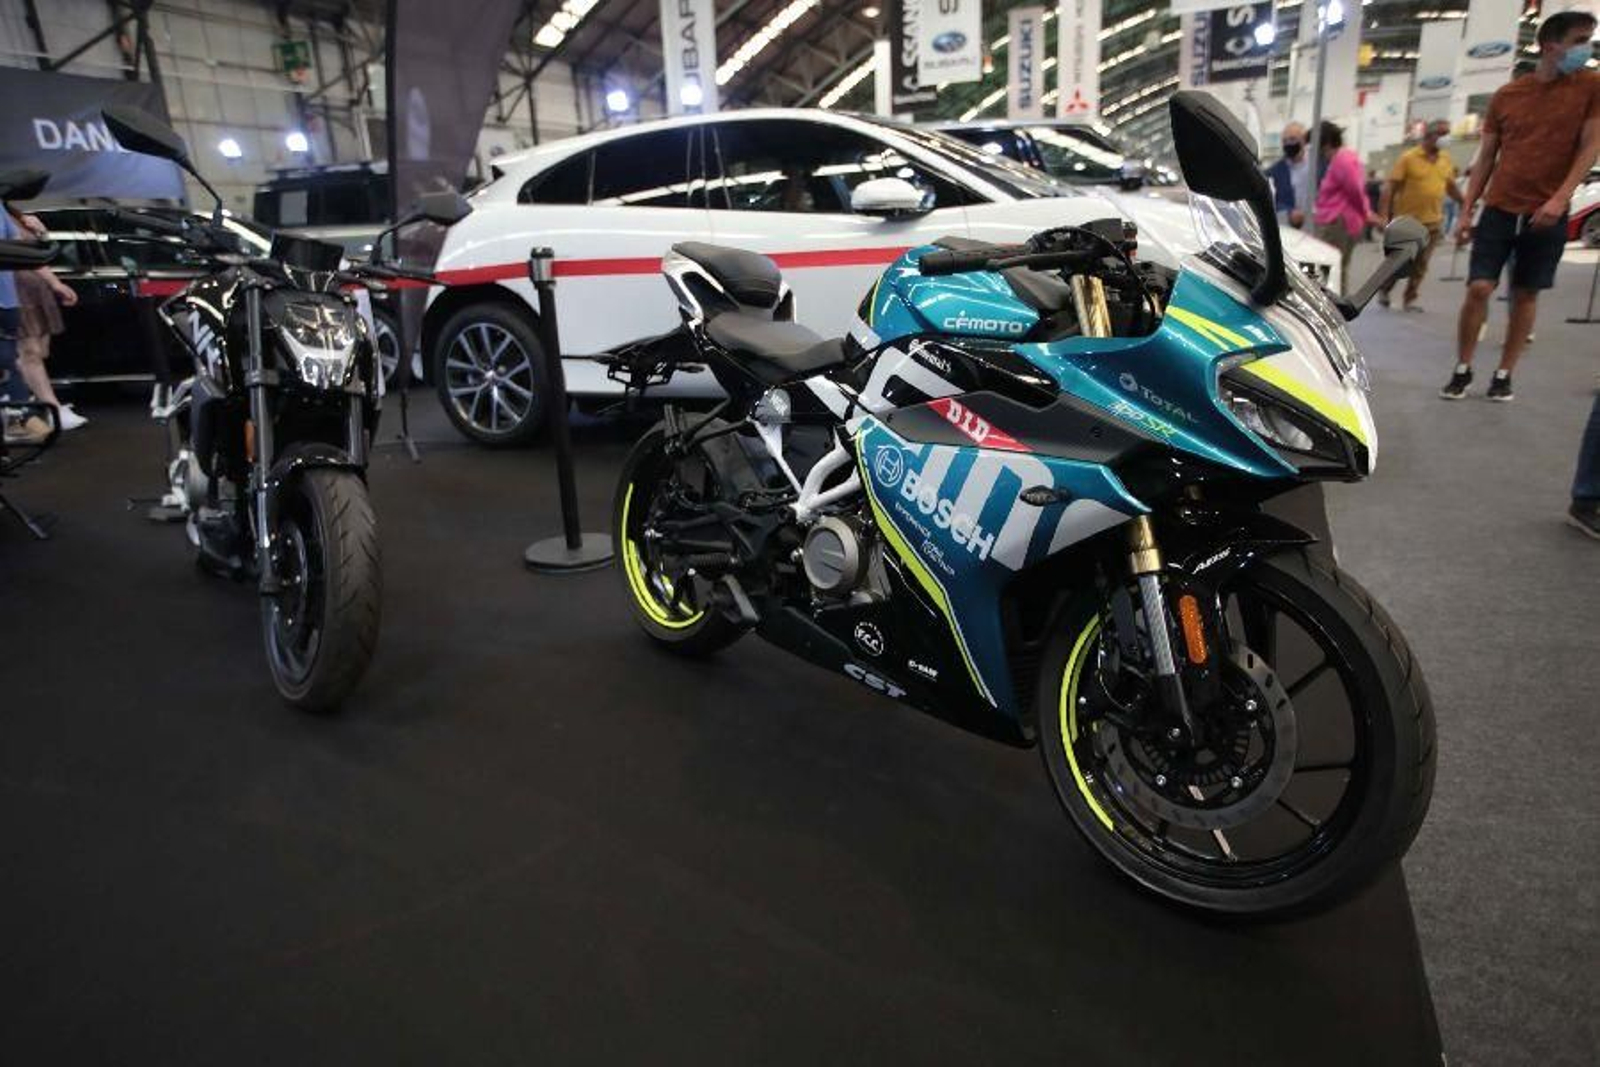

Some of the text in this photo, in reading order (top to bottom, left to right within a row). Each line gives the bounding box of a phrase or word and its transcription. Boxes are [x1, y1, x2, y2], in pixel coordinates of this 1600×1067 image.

[1019, 19, 1032, 108] SUZUKI
[33, 118, 132, 153] DAN
[943, 311, 1023, 332] CFMOTO
[1139, 385, 1200, 424] TOTAL
[901, 468, 995, 561] BOSCH
[844, 664, 907, 698] CST
